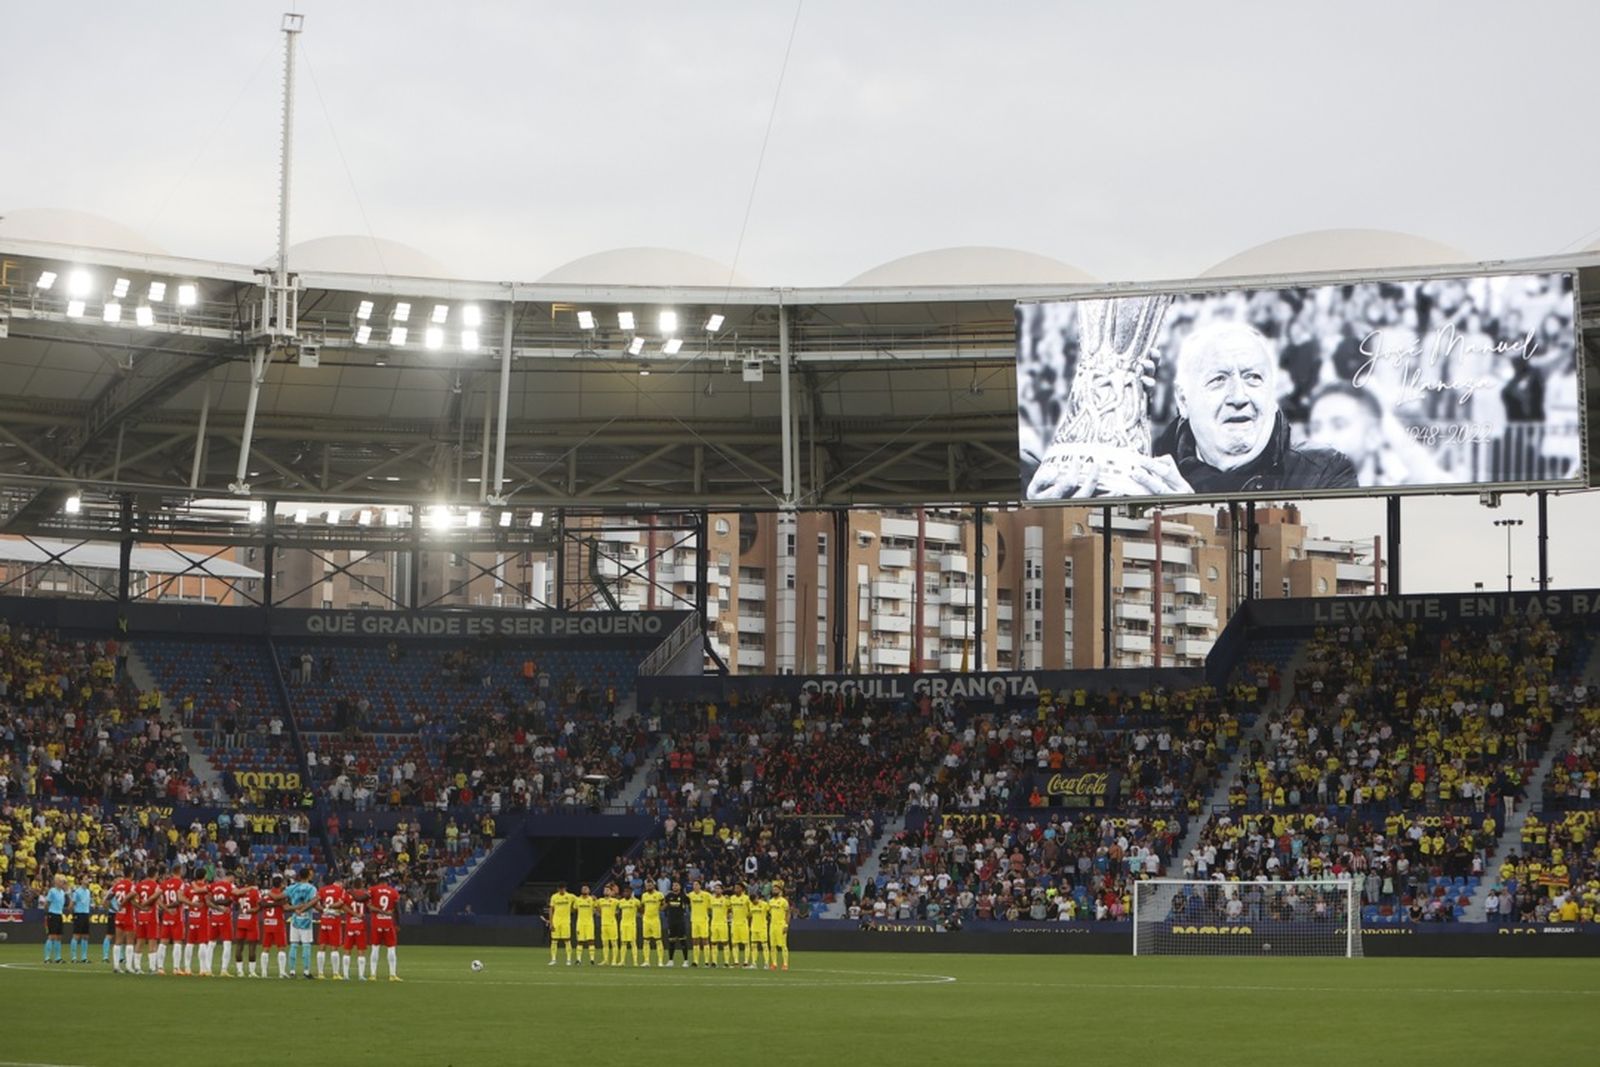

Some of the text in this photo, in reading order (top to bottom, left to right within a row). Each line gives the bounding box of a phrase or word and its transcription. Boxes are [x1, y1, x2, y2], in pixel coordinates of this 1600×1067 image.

[1431, 322, 1539, 366] Manuel
[1403, 423, 1492, 447] 948-2022
[1315, 599, 1447, 620] LEVANTE,
[1460, 598, 1496, 617] EN
[306, 611, 662, 636] QUÉ GRANDE ES SER PEQUEÑO
[379, 895, 390, 912] 9
